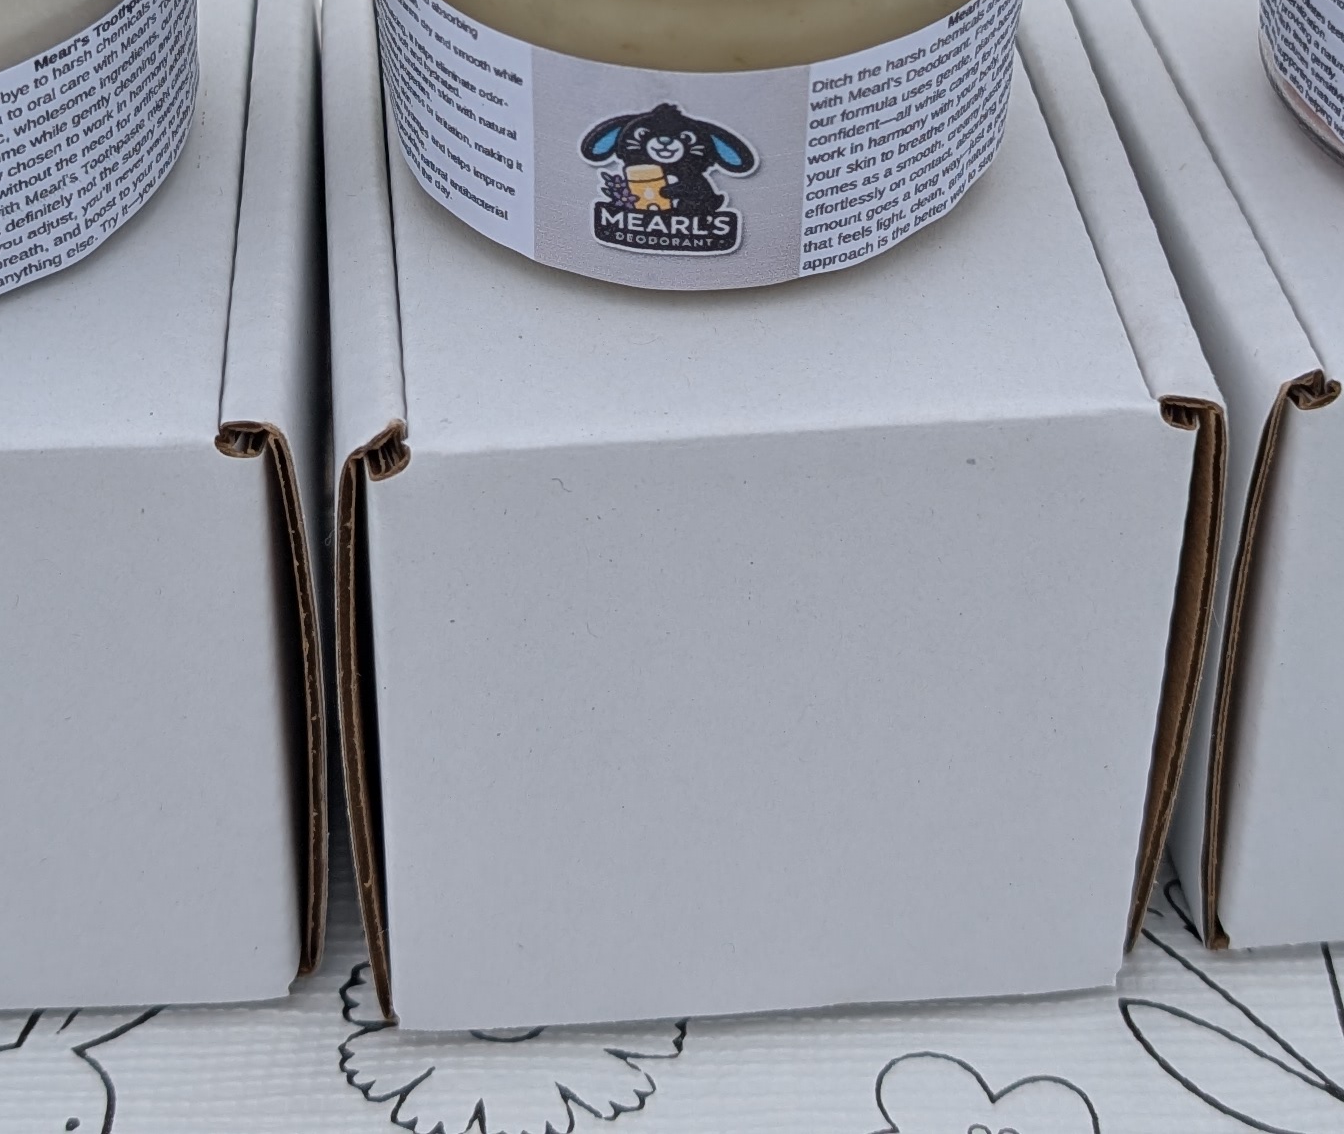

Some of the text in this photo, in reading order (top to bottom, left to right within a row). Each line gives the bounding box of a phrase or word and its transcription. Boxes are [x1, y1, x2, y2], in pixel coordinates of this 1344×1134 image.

[33, 75, 49, 89] to
[52, 48, 92, 80] harsh
[96, 1, 151, 54] chemicals
[431, 1, 478, 40] absorbing
[34, 35, 90, 72] Mearl's
[434, 31, 523, 86] and smooth while
[435, 60, 477, 93] eliminate
[812, 9, 985, 94] Ditch the harsh chemicals
[7, 107, 23, 120] to
[27, 88, 56, 112] oral
[59, 70, 90, 95] care
[93, 49, 118, 74] with
[29, 121, 68, 147] while
[71, 92, 111, 128] gently
[114, 50, 156, 97] cleaning
[809, 79, 933, 130] our formula uses
[810, 76, 903, 112] with Mearl's
[914, 60, 980, 112] while caring
[7, 143, 62, 177] chosen
[65, 133, 80, 147] to
[83, 109, 114, 137] work
[116, 99, 127, 114] in
[13, 86, 96, 137] wholesome
[456, 102, 476, 121] with
[478, 117, 517, 140] natural
[807, 146, 847, 165] work
[850, 142, 864, 155] in
[868, 114, 929, 150] harmony
[931, 98, 954, 120] with
[25, 172, 78, 206] Mearl's
[81, 118, 145, 174] Toothpaste
[55, 153, 77, 172] the
[81, 126, 113, 157] need
[116, 113, 132, 132] for
[431, 134, 516, 196] and helps improve
[474, 142, 513, 169] making
[806, 121, 945, 187] your skin to breathe
[5, 193, 73, 233] definitely
[77, 176, 97, 198] not
[99, 161, 119, 181] the
[27, 211, 77, 239] adjust,
[81, 181, 112, 217] you'll
[53, 223, 81, 247] and
[84, 196, 116, 230] boost
[119, 186, 130, 201] to
[132, 161, 154, 192] your
[449, 179, 508, 221] antibacterial
[803, 173, 940, 236] amount goes a long
[805, 167, 893, 202] comes as a
[805, 177, 906, 219] effortlessly on
[66, 234, 98, 259] else.
[99, 212, 119, 233] Try
[600, 207, 731, 236] MEARL'S
[614, 232, 714, 247] DEODORANT
[802, 179, 967, 271] approach is the better way
[803, 226, 873, 253] that feels
